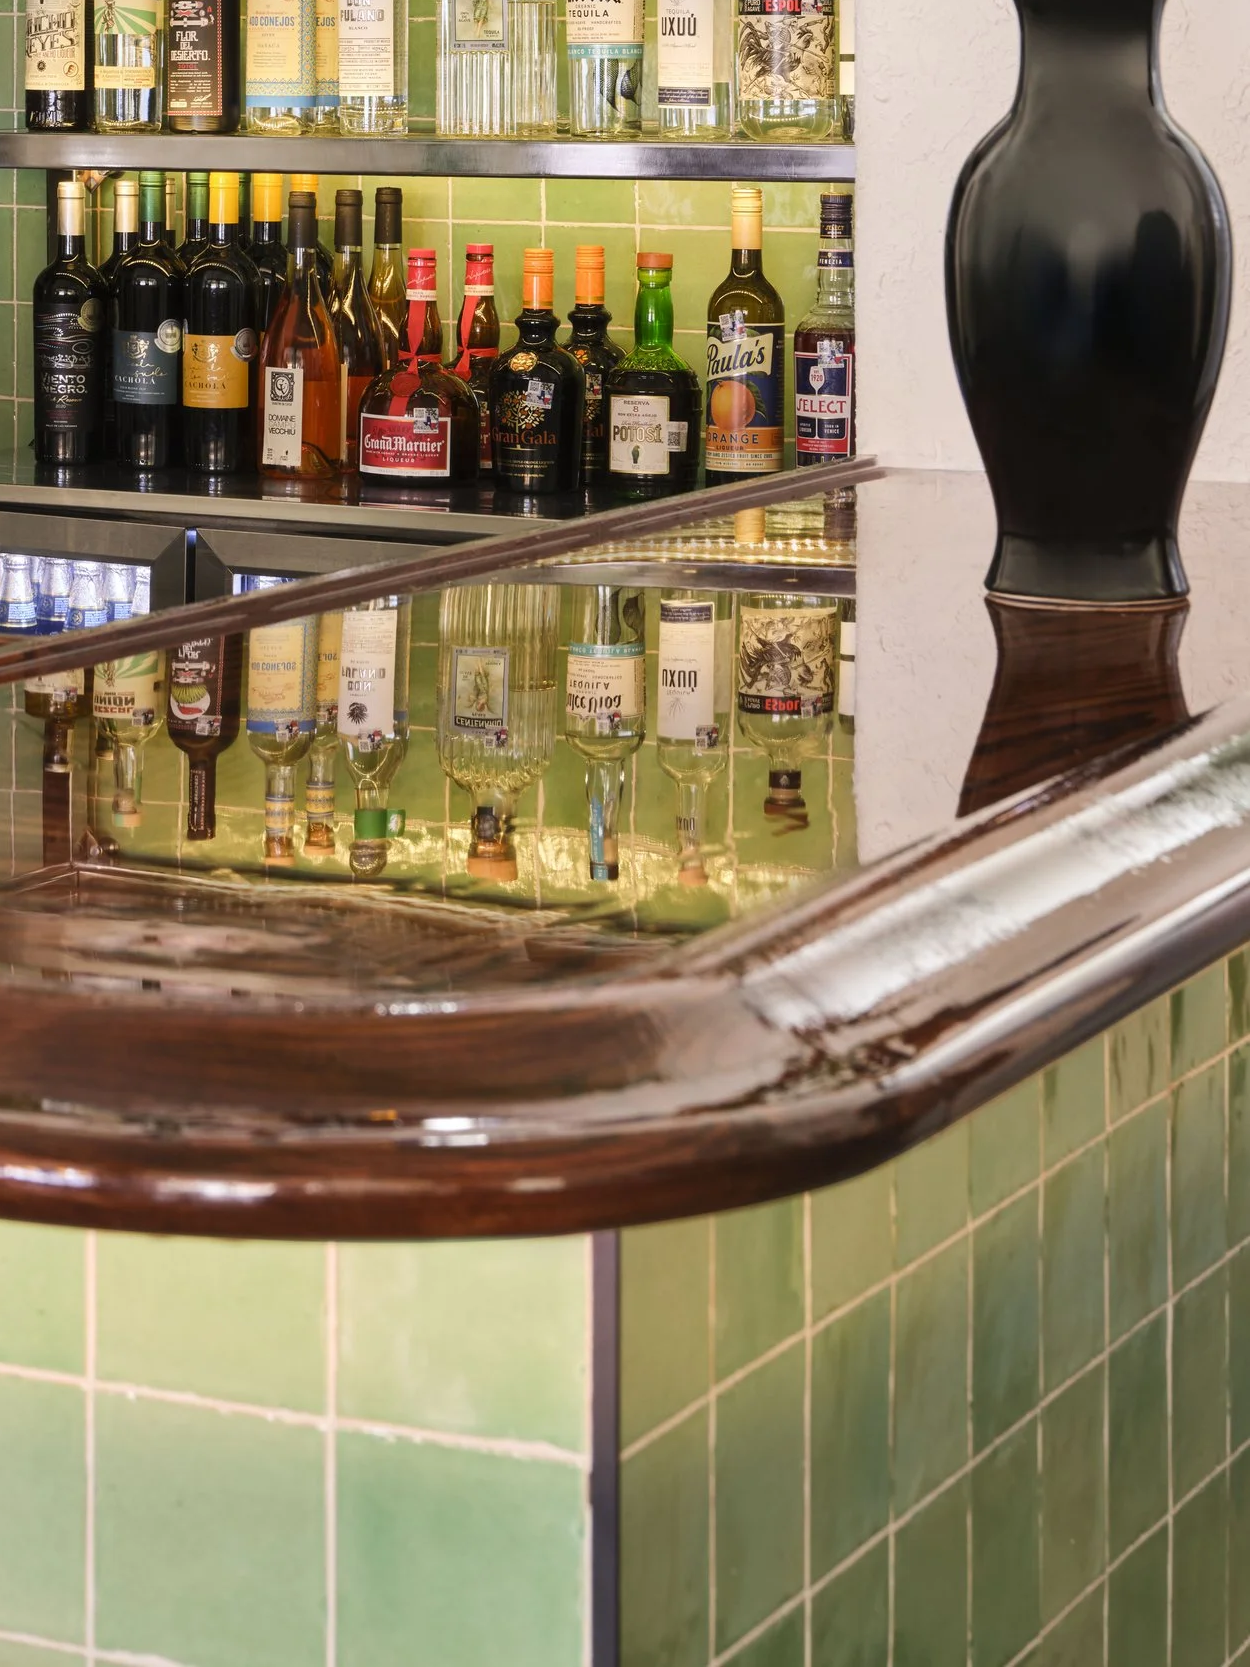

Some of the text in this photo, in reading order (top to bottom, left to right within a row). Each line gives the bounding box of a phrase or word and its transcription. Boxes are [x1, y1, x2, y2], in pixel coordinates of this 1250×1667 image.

[340, 9, 384, 21] FULANO
[260, 16, 295, 26] CONEJOS
[316, 16, 336, 27] EJOS
[661, 14, 697, 36] UXUÚ
[180, 42, 192, 50] DEL
[707, 340, 765, 377] Paula's
[42, 373, 85, 384] VIENTO
[811, 374, 823, 382] 1920
[797, 398, 846, 414] SELECT
[268, 414, 296, 422] DOMAINE
[268, 427, 296, 436] VECCHIU
[364, 433, 441, 453] Grand Marnier
[707, 432, 759, 444] ORANGE
